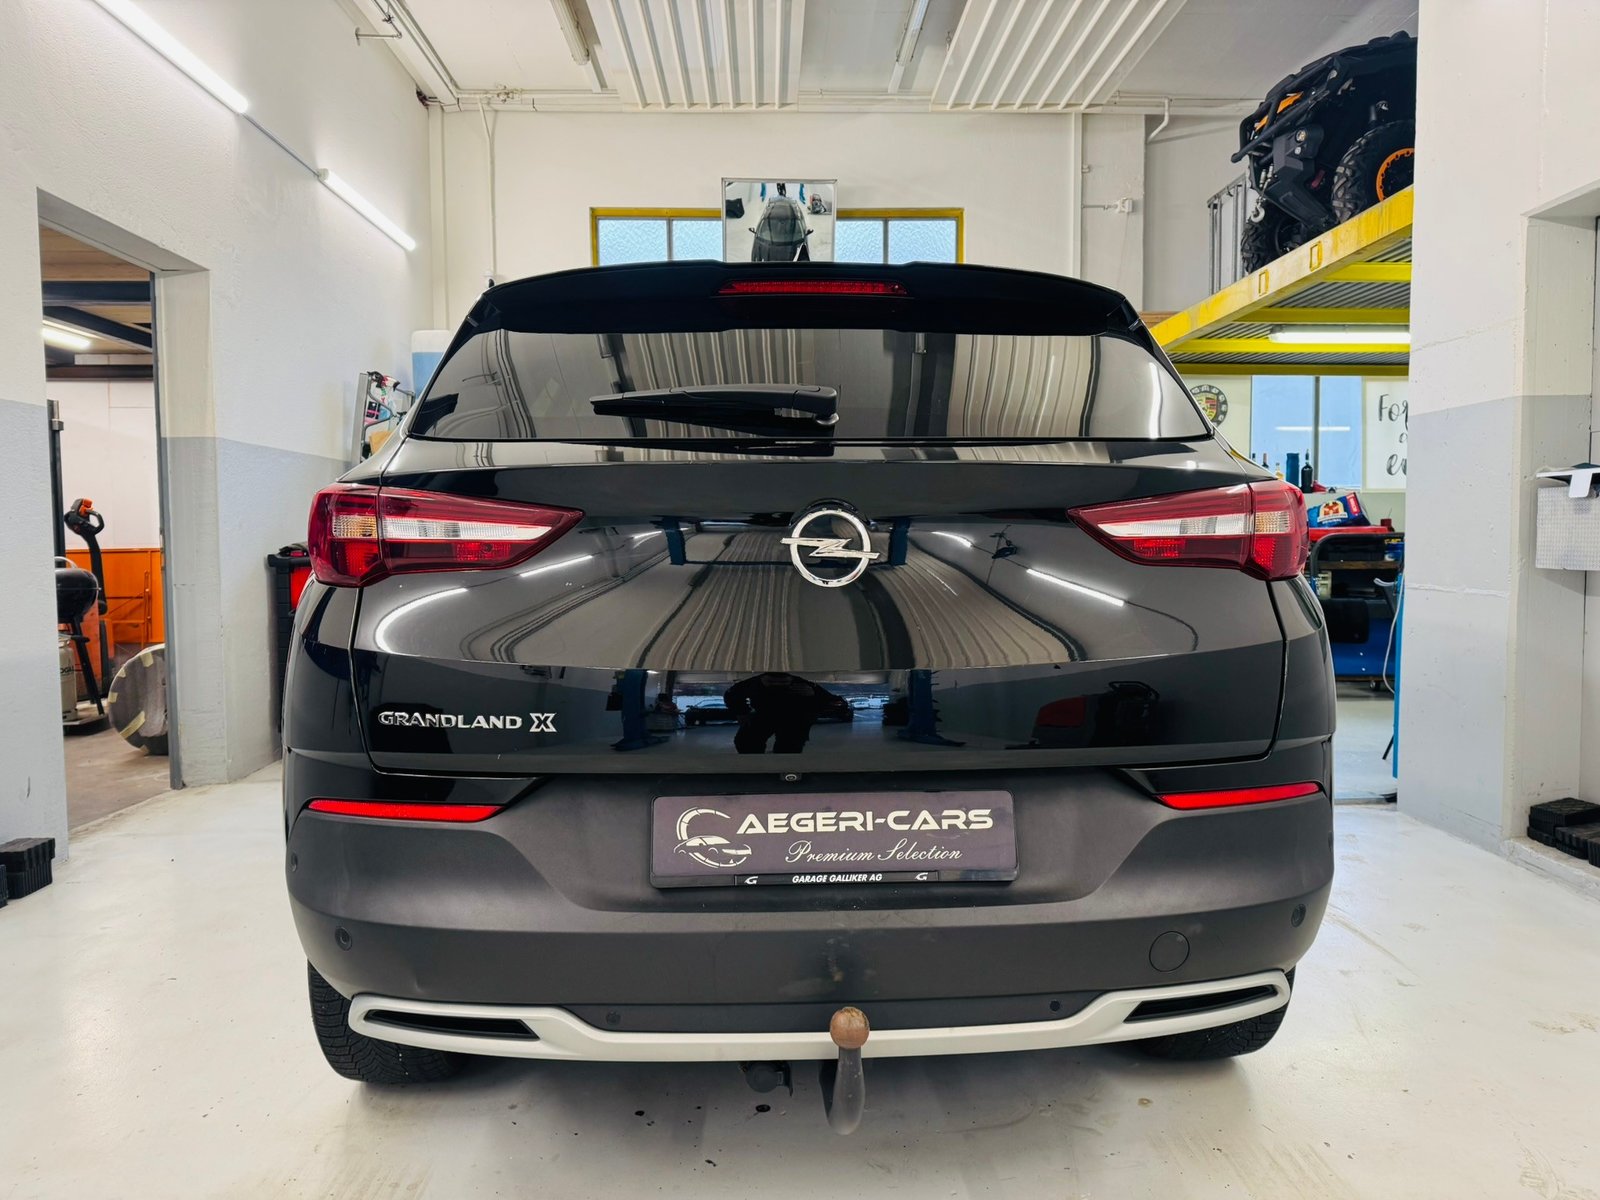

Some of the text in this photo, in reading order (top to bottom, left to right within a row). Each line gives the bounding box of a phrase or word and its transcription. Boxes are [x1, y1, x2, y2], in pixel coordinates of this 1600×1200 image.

[377, 711, 557, 732] GRANDLAND X
[736, 808, 994, 835] AEGERI-CARS
[785, 838, 963, 864] Premium Selection
[792, 873, 883, 884] GARAGE GALLIKER AG
